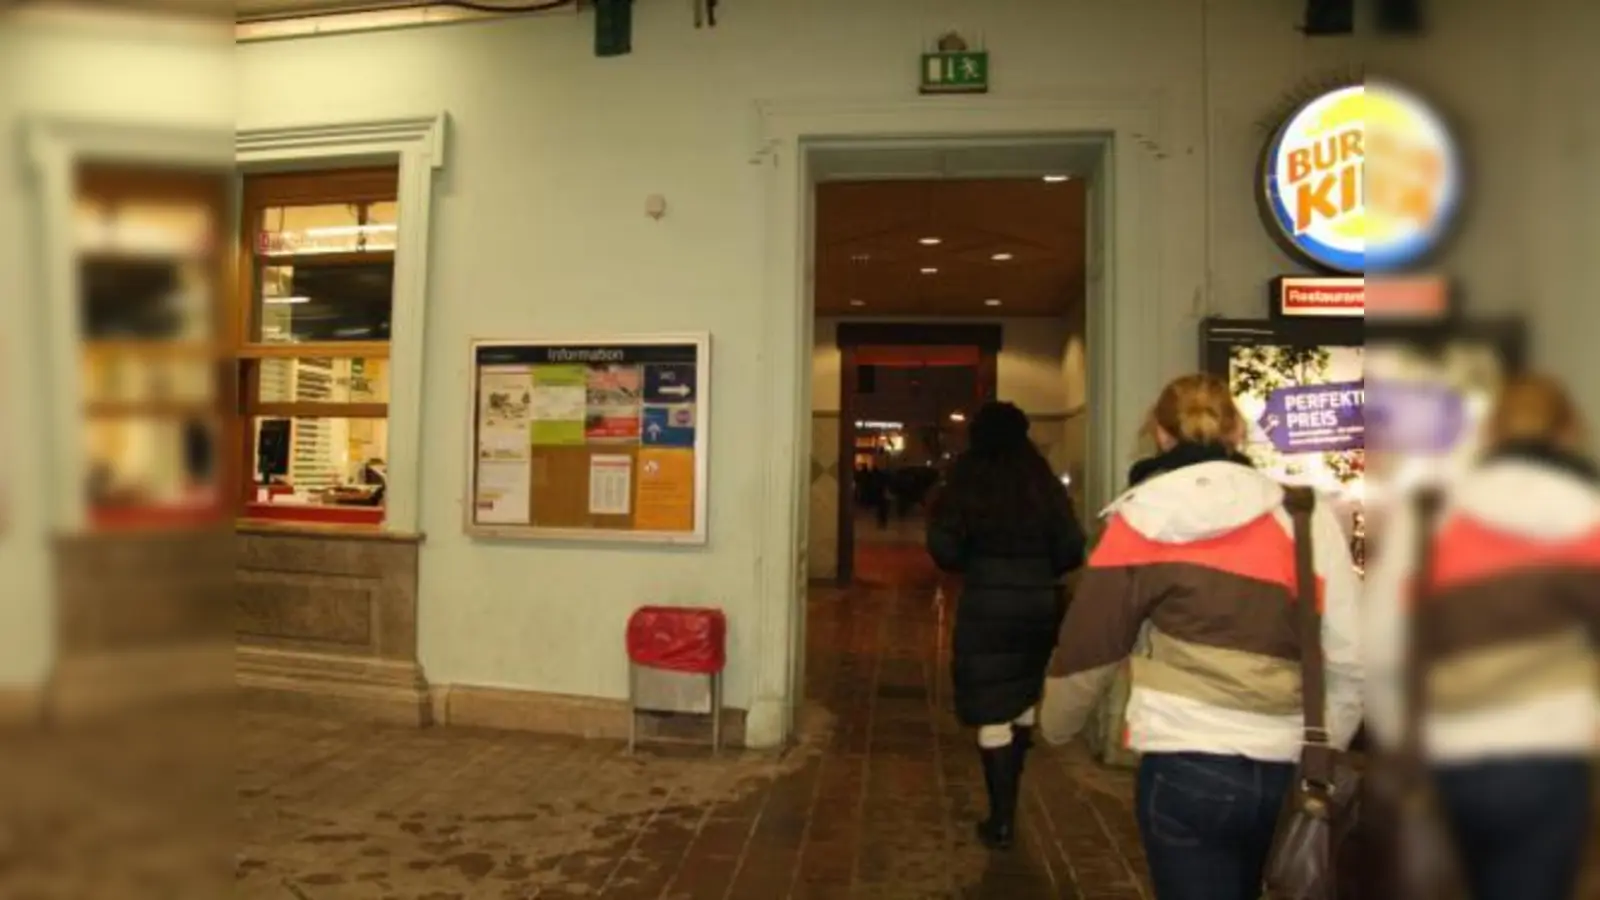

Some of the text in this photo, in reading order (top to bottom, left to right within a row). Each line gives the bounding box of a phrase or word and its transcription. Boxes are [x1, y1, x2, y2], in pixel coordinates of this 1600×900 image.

[1296, 159, 1364, 231] KI
[547, 347, 625, 362] Information
[1286, 408, 1338, 429] PREIS
